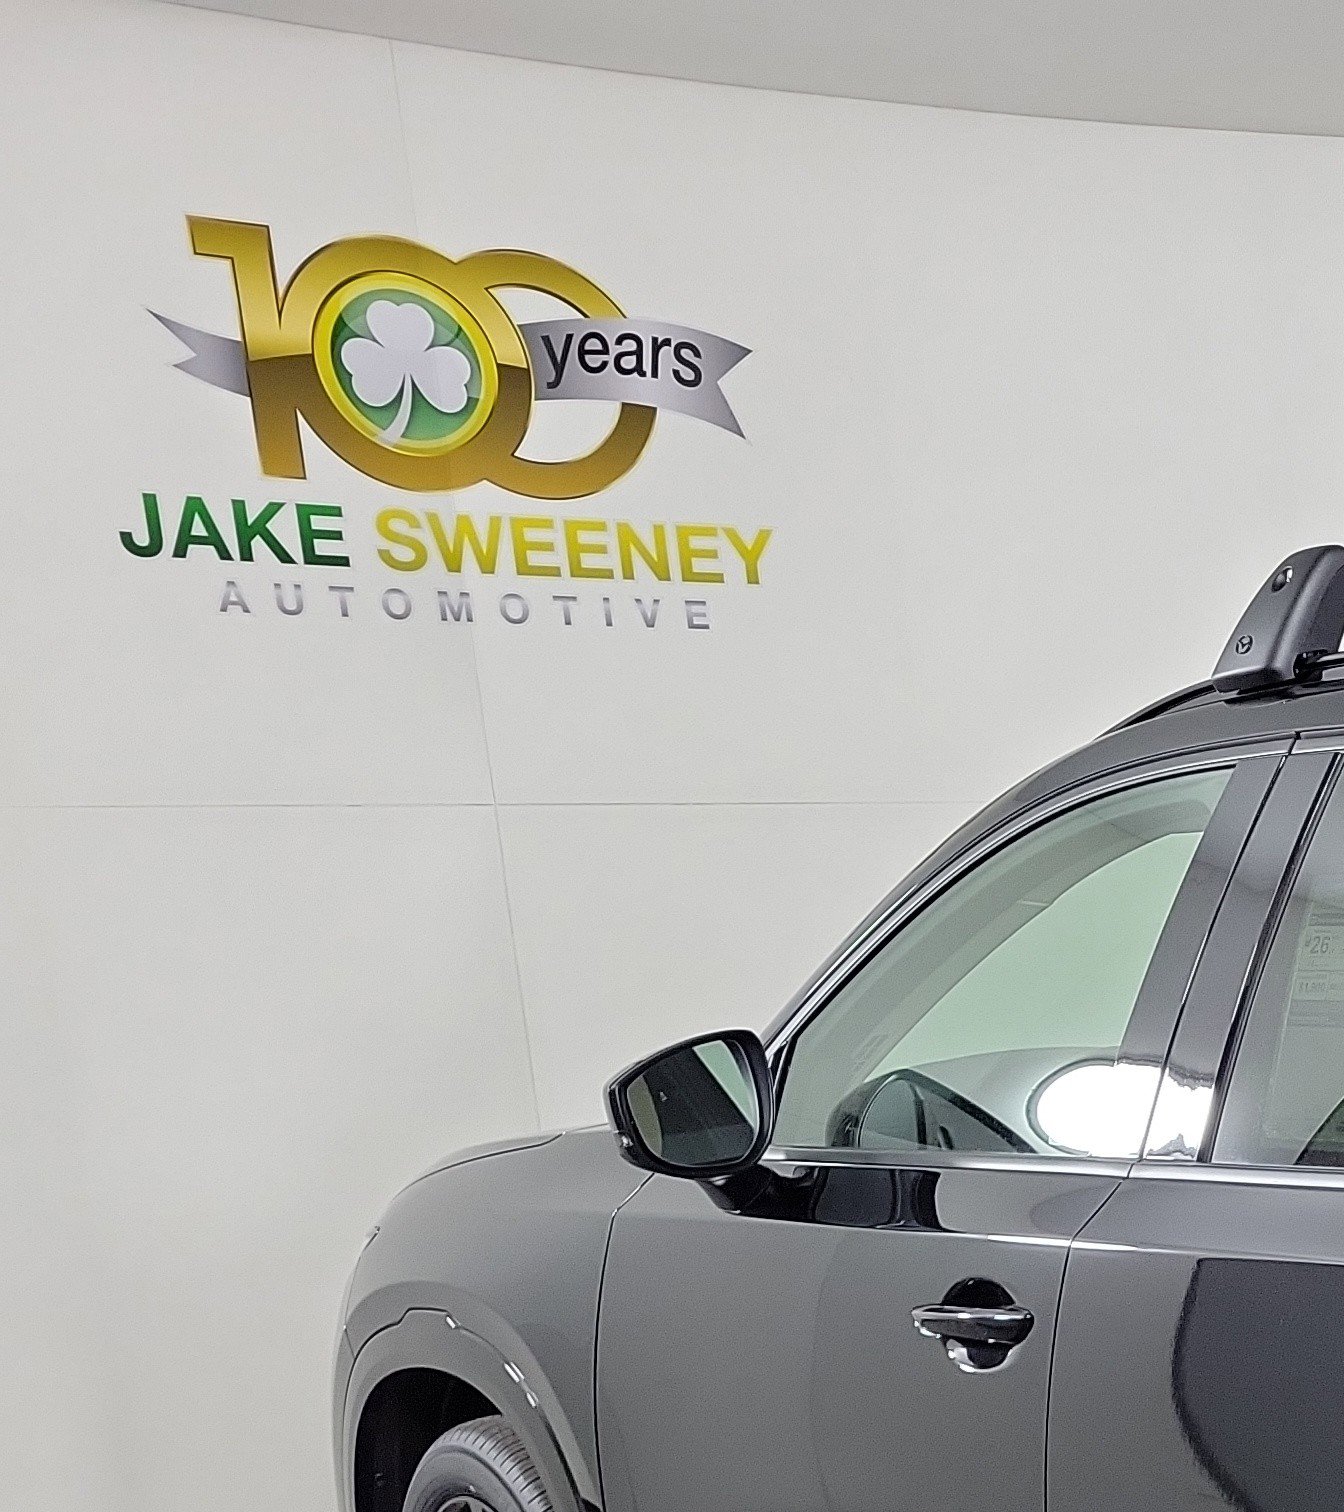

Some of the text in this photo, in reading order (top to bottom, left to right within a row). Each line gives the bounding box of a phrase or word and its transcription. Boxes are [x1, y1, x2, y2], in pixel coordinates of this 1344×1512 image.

[186, 214, 702, 501] 100 years
[119, 492, 773, 586] JAKE SWEENEY
[218, 580, 711, 630] AUTOMOTIVE
